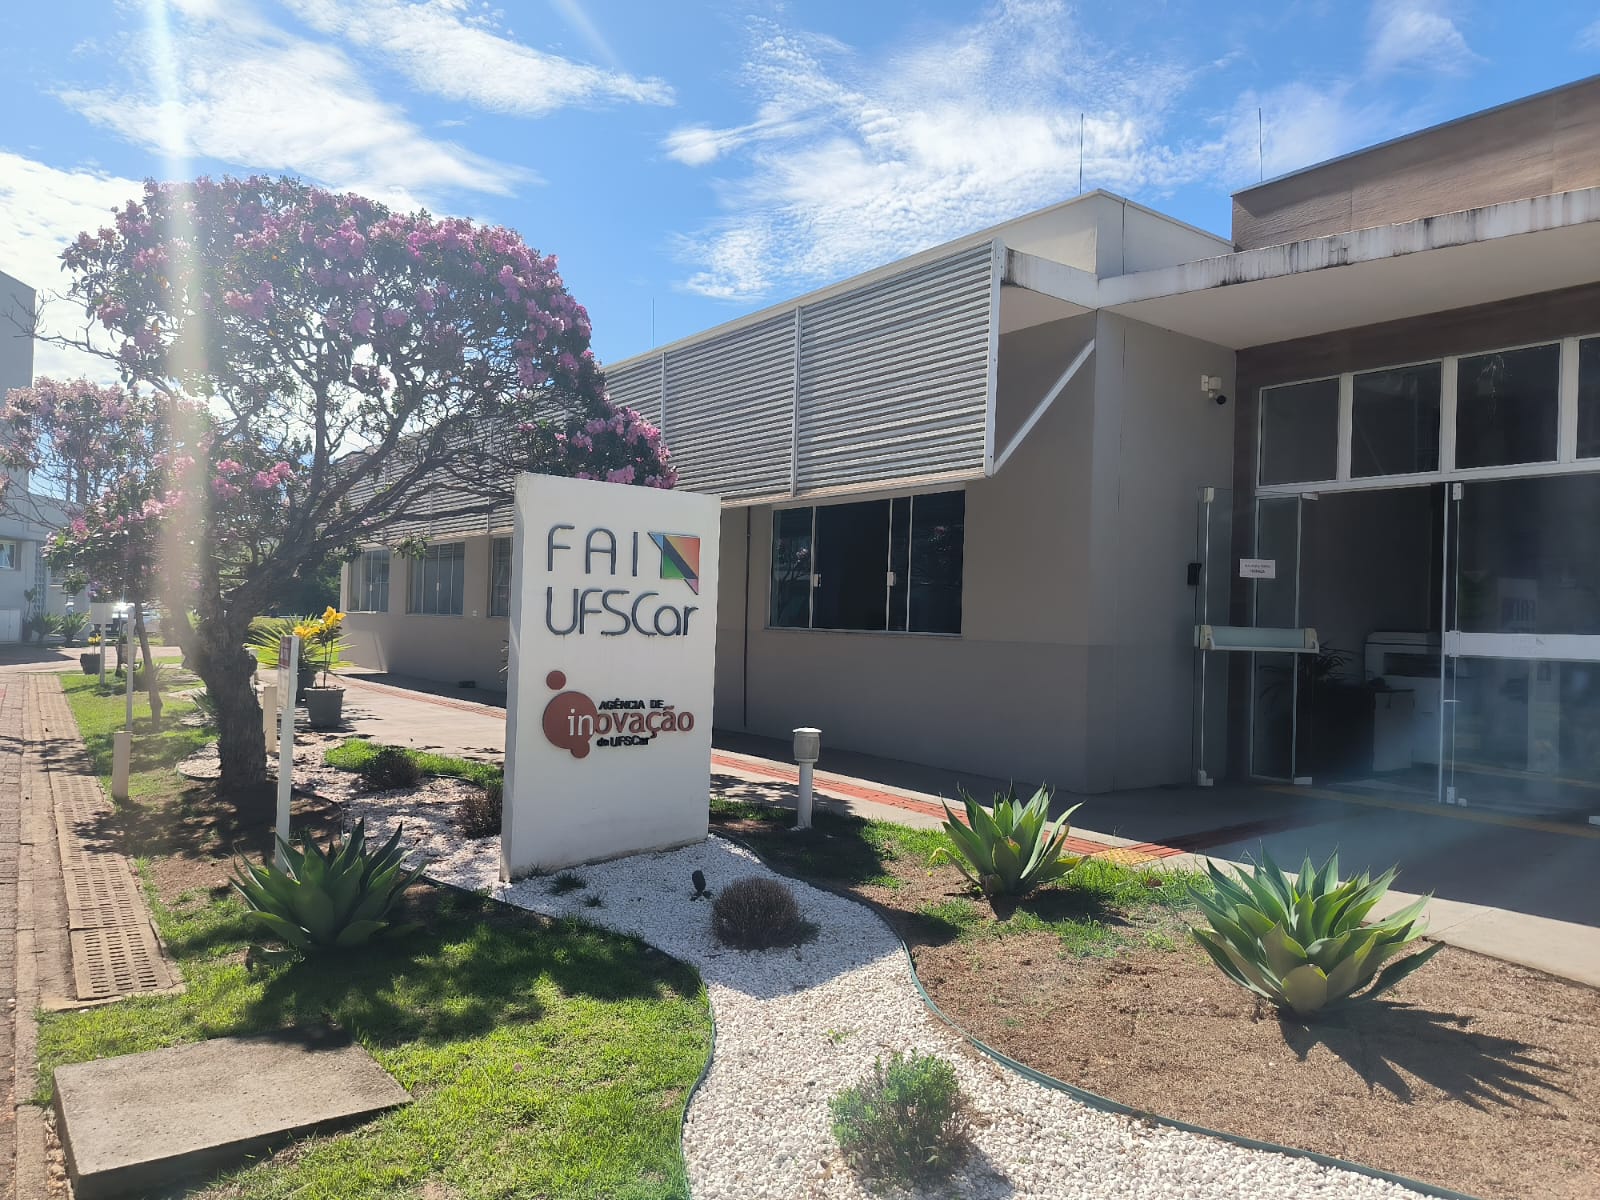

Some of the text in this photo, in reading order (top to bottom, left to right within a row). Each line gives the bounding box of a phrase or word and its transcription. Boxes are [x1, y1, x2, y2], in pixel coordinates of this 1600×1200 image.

[547, 524, 639, 577] FAI
[546, 586, 699, 636] UFSCar
[598, 698, 664, 711] AGÊNCIA DE
[567, 705, 695, 738] inovação
[610, 735, 650, 747] UFSCar
